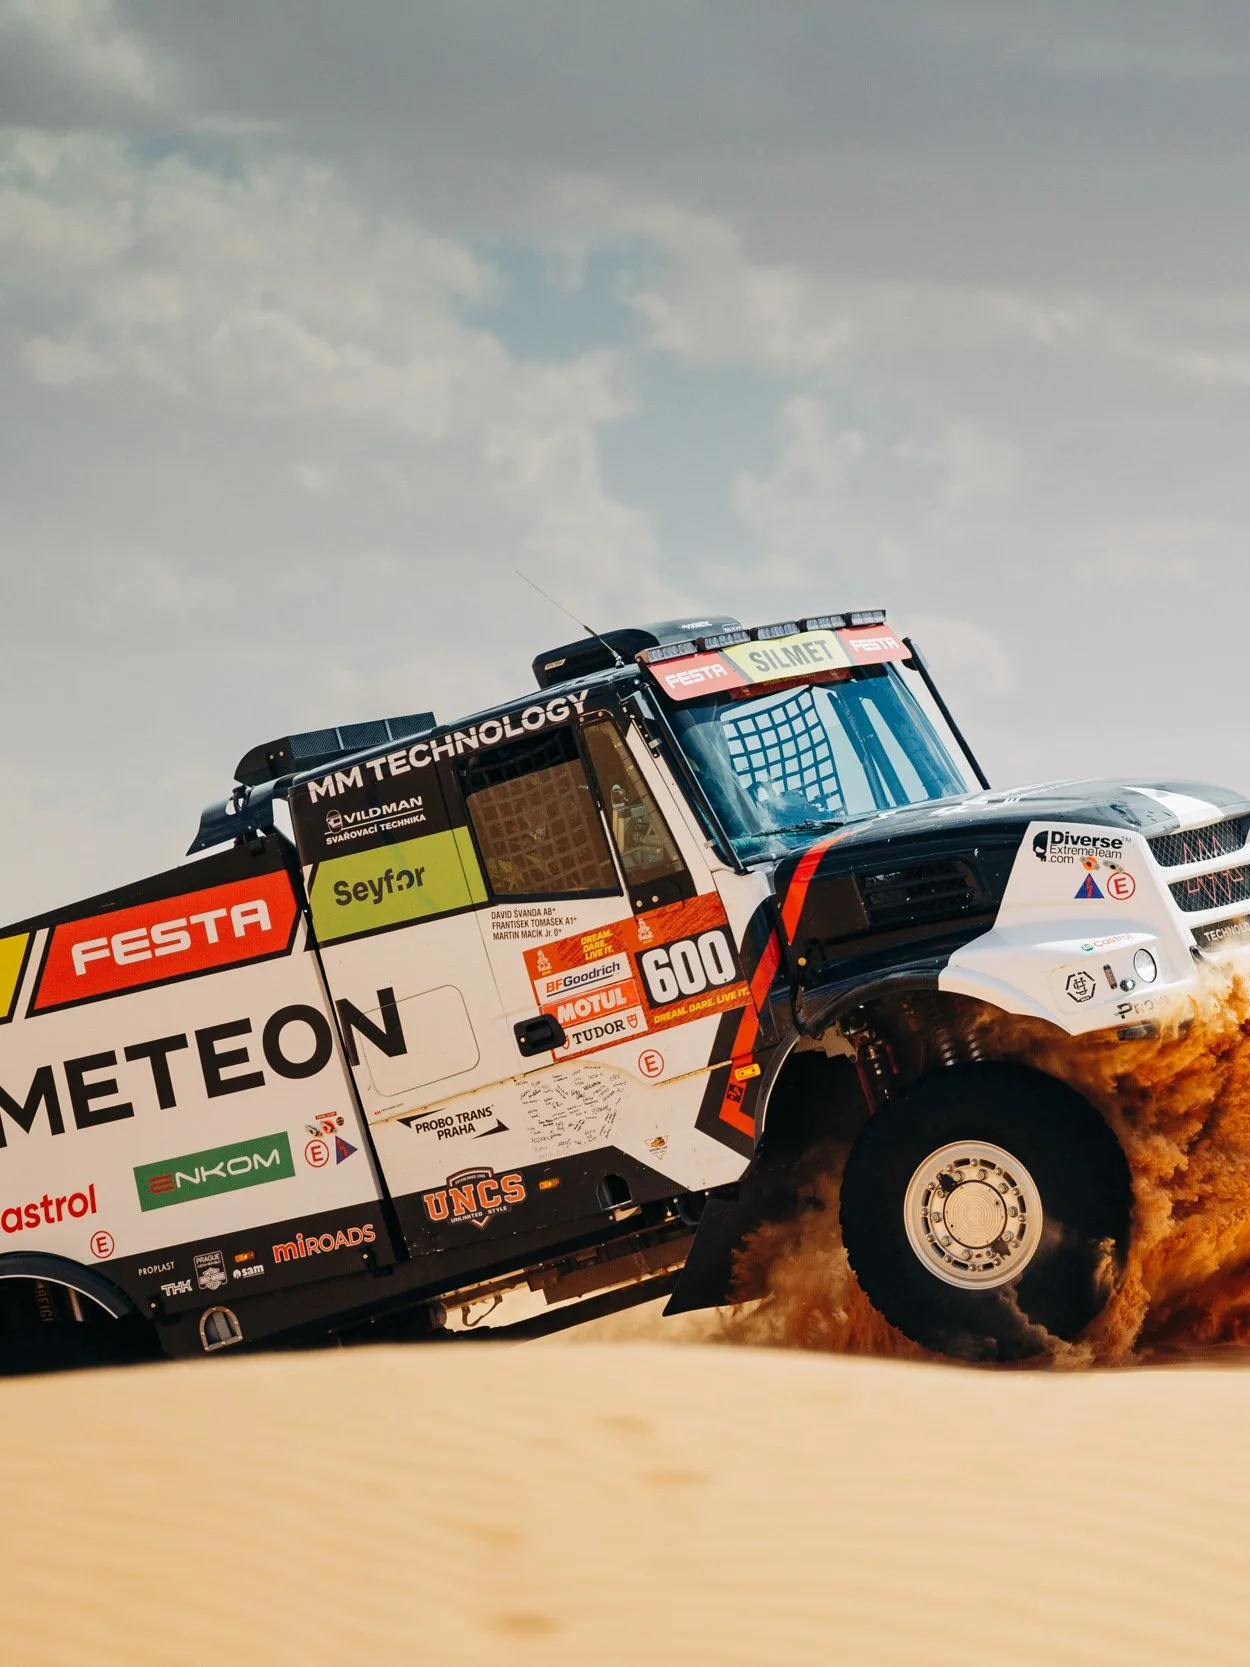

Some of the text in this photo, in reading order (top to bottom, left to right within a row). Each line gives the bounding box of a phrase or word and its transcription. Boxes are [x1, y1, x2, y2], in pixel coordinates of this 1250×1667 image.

[849, 636, 900, 653] FESTA
[748, 639, 835, 673] SILMET
[664, 664, 728, 689] FESTA
[307, 689, 589, 804] MM TECHNOLOGY
[343, 796, 423, 823] VILDMAN
[380, 814, 426, 831] TECHNIKA
[1050, 830, 1123, 849] Diverse
[1048, 855, 1074, 864] .com
[1049, 844, 1122, 859] ExtremeTeam
[333, 866, 425, 906] Seyfor
[491, 910, 512, 920] DAVID
[70, 899, 272, 976] FESTA
[493, 930, 520, 940] MARTIN
[581, 929, 613, 945] DREAM.
[1093, 933, 1132, 948] Castrol
[583, 939, 608, 953] DARE.
[585, 948, 603, 960] LIVE
[641, 930, 736, 1003] 600
[546, 961, 620, 993] BFGoodrich
[557, 987, 627, 1023] MOTUL
[653, 1006, 688, 1024] DREAM.
[689, 998, 716, 1013] DARE.
[717, 991, 737, 1004] LIVE
[572, 1019, 626, 1044] TUDOR
[0, 987, 408, 1149] METEON
[415, 1116, 454, 1134] PROBO
[437, 1123, 476, 1140] PRAHA
[148, 1149, 280, 1194] ENKOM
[423, 1173, 526, 1221] UNCS
[0, 1183, 97, 1233] astrol
[451, 1205, 508, 1223] UNLIMITED STYLE
[196, 1252, 221, 1265] PRAGUE
[138, 1261, 175, 1276] PROPLAST
[241, 1264, 264, 1277] sam
[161, 1279, 193, 1297] THK
